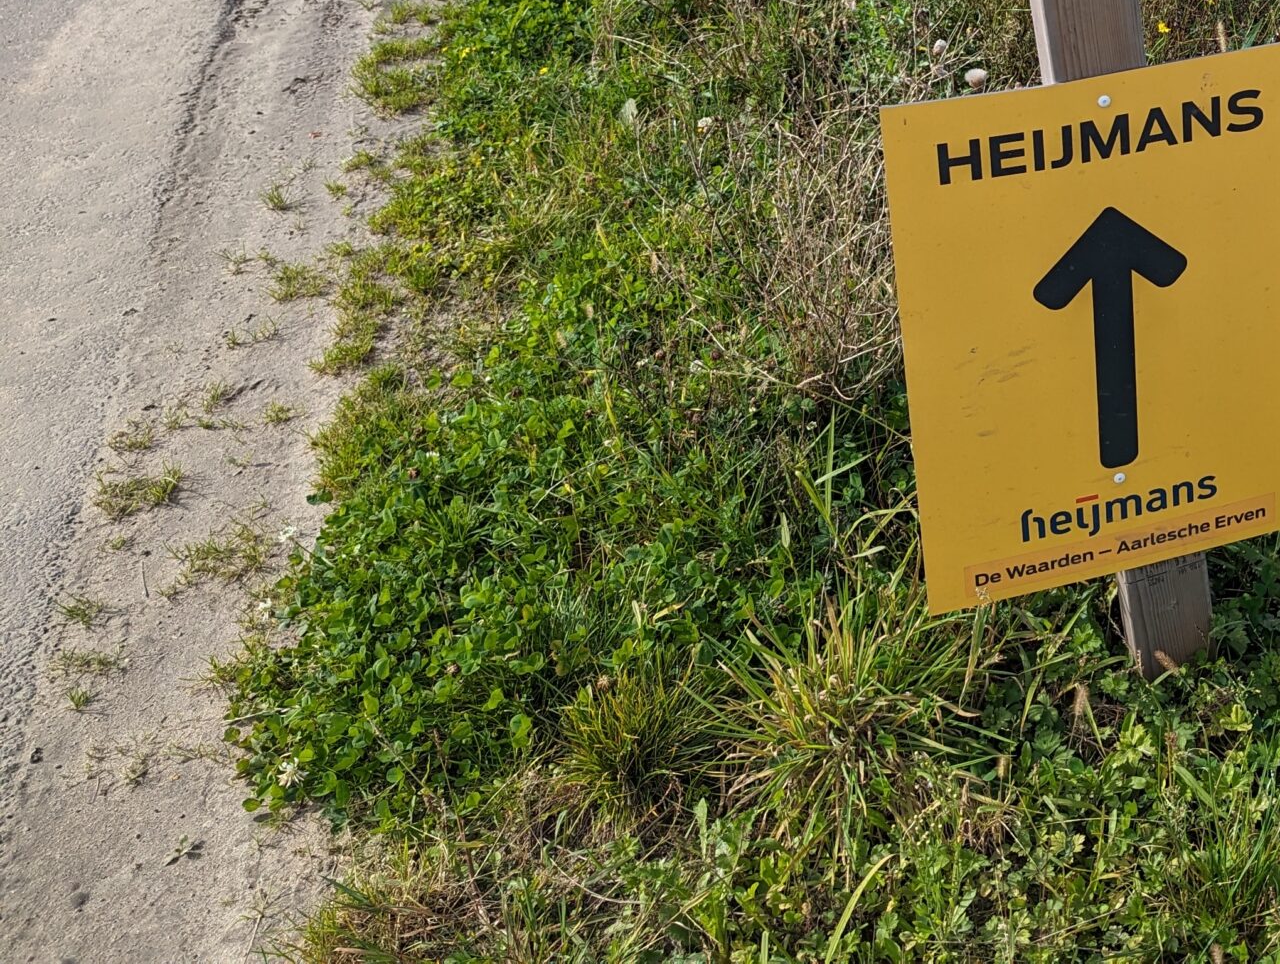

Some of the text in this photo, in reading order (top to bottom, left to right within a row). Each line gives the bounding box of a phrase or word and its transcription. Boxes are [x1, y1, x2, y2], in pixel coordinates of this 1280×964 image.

[936, 89, 1264, 186] HEIJMANS
[974, 572, 1002, 588] De
[1005, 551, 1095, 580] Waarden
[1116, 521, 1211, 555] Aarlesche
[1214, 507, 1267, 530] Erven
[1020, 475, 1218, 543] heijmans
